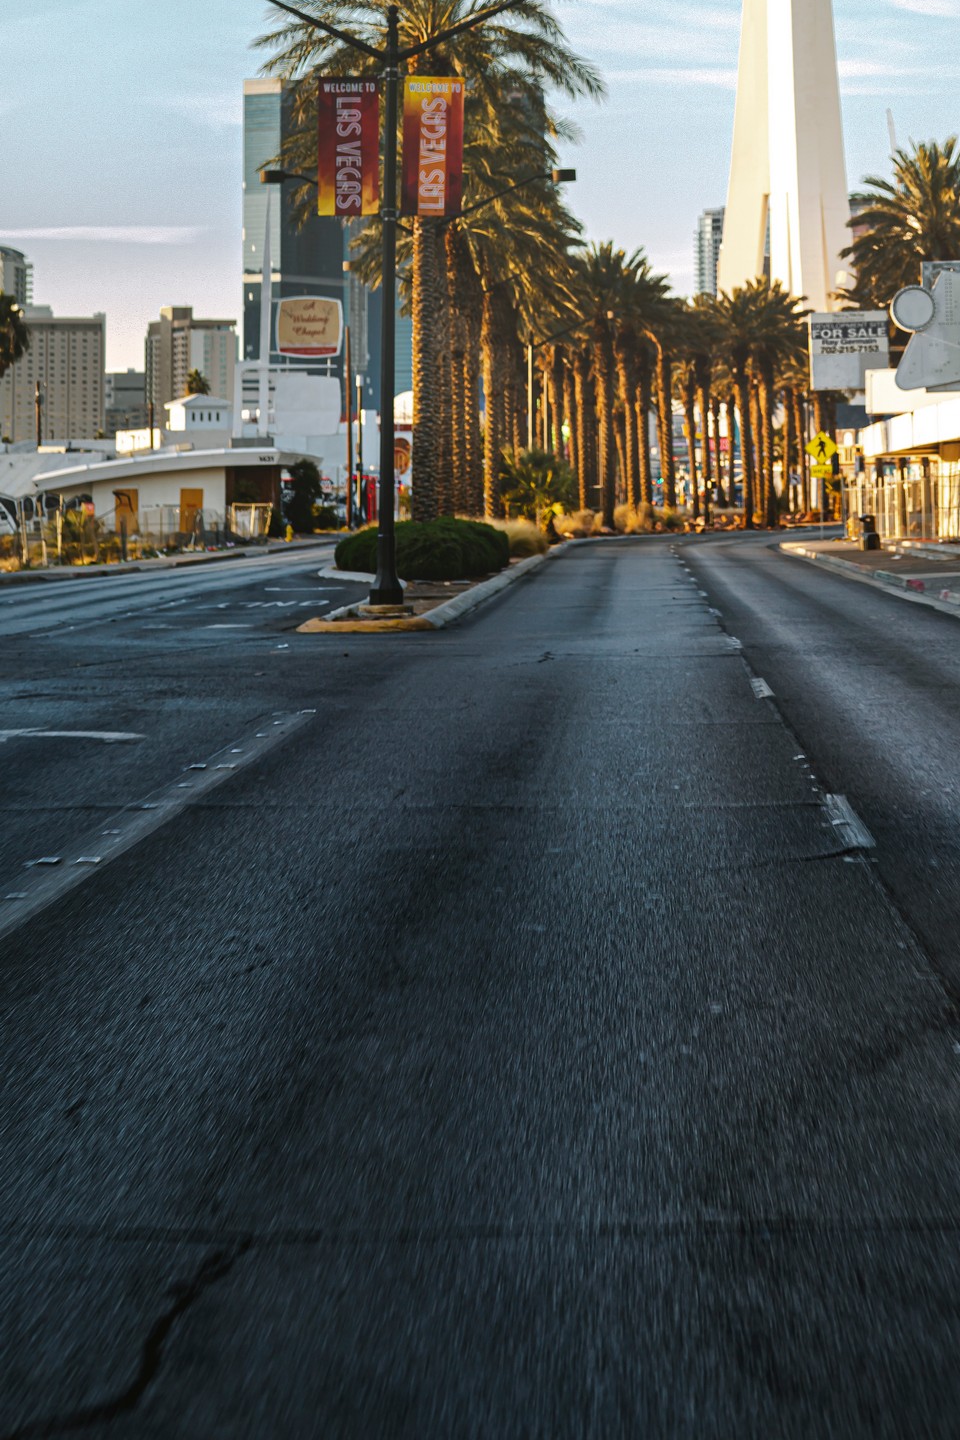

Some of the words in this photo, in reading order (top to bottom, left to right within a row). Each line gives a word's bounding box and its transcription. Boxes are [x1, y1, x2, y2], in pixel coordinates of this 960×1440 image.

[323, 82, 363, 93] WELCOME
[365, 82, 376, 93] TO
[409, 82, 449, 93] WELCOME
[451, 82, 461, 93] TO
[336, 96, 362, 137] LAS
[420, 97, 447, 165] VEGAS
[336, 140, 362, 209] VEGAS
[419, 168, 446, 210] LAS
[812, 329, 843, 338] FOR
[847, 327, 887, 338] SALE
